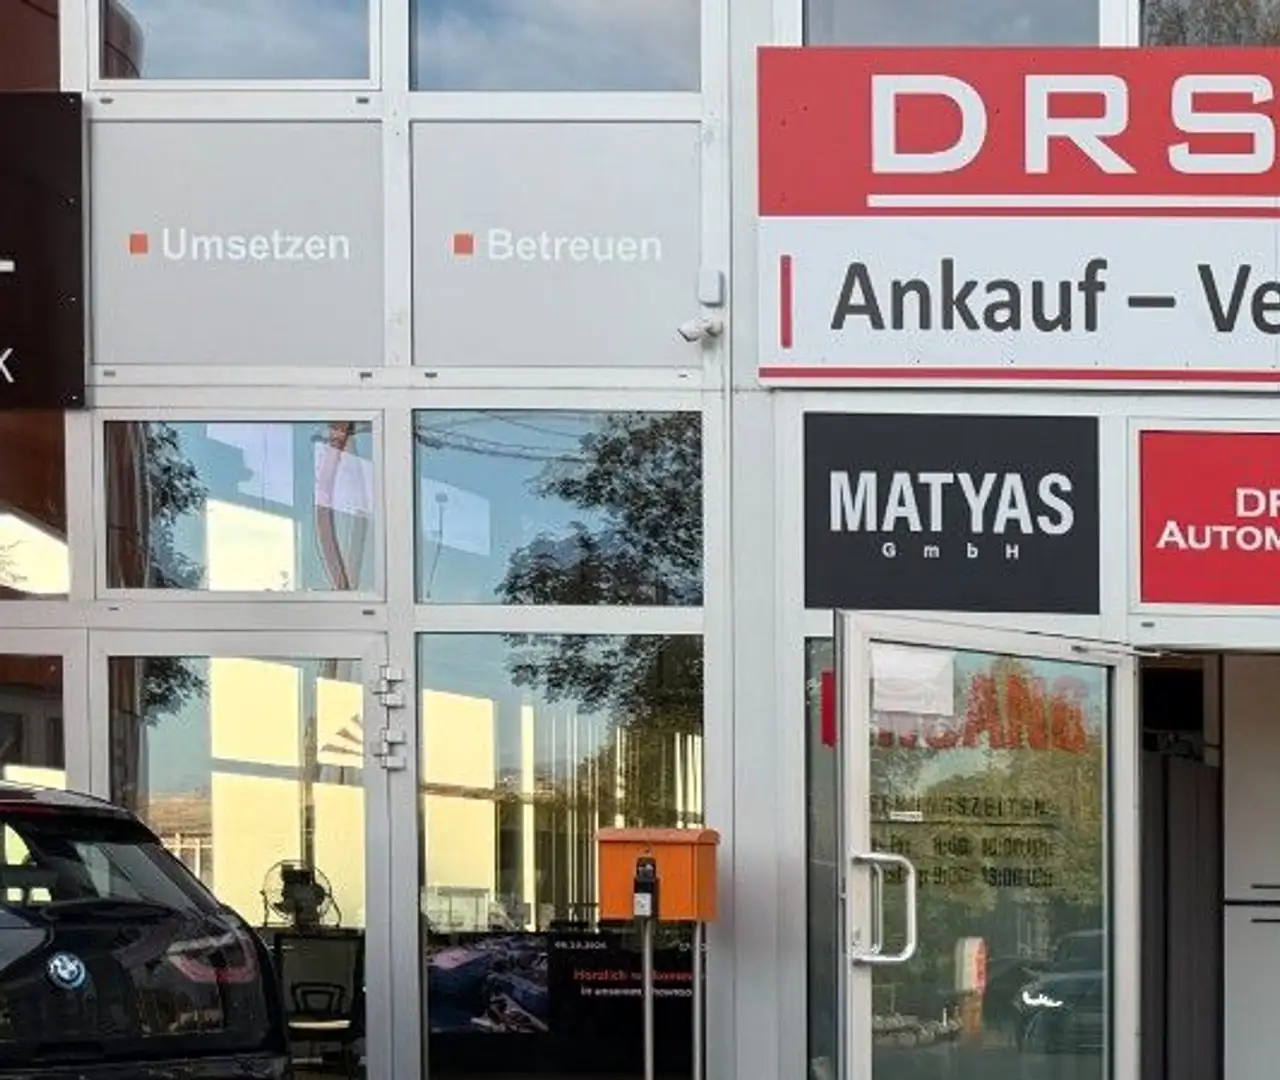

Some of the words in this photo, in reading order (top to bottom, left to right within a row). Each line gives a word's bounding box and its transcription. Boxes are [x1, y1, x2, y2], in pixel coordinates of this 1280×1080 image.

[870, 74, 1277, 174] DRS
[163, 228, 350, 261] Umsetzen
[487, 228, 662, 262] Betreuen
[830, 258, 1108, 333] Ankauf
[830, 471, 1075, 535] MATYAS
[883, 542, 1019, 559] GmbH
